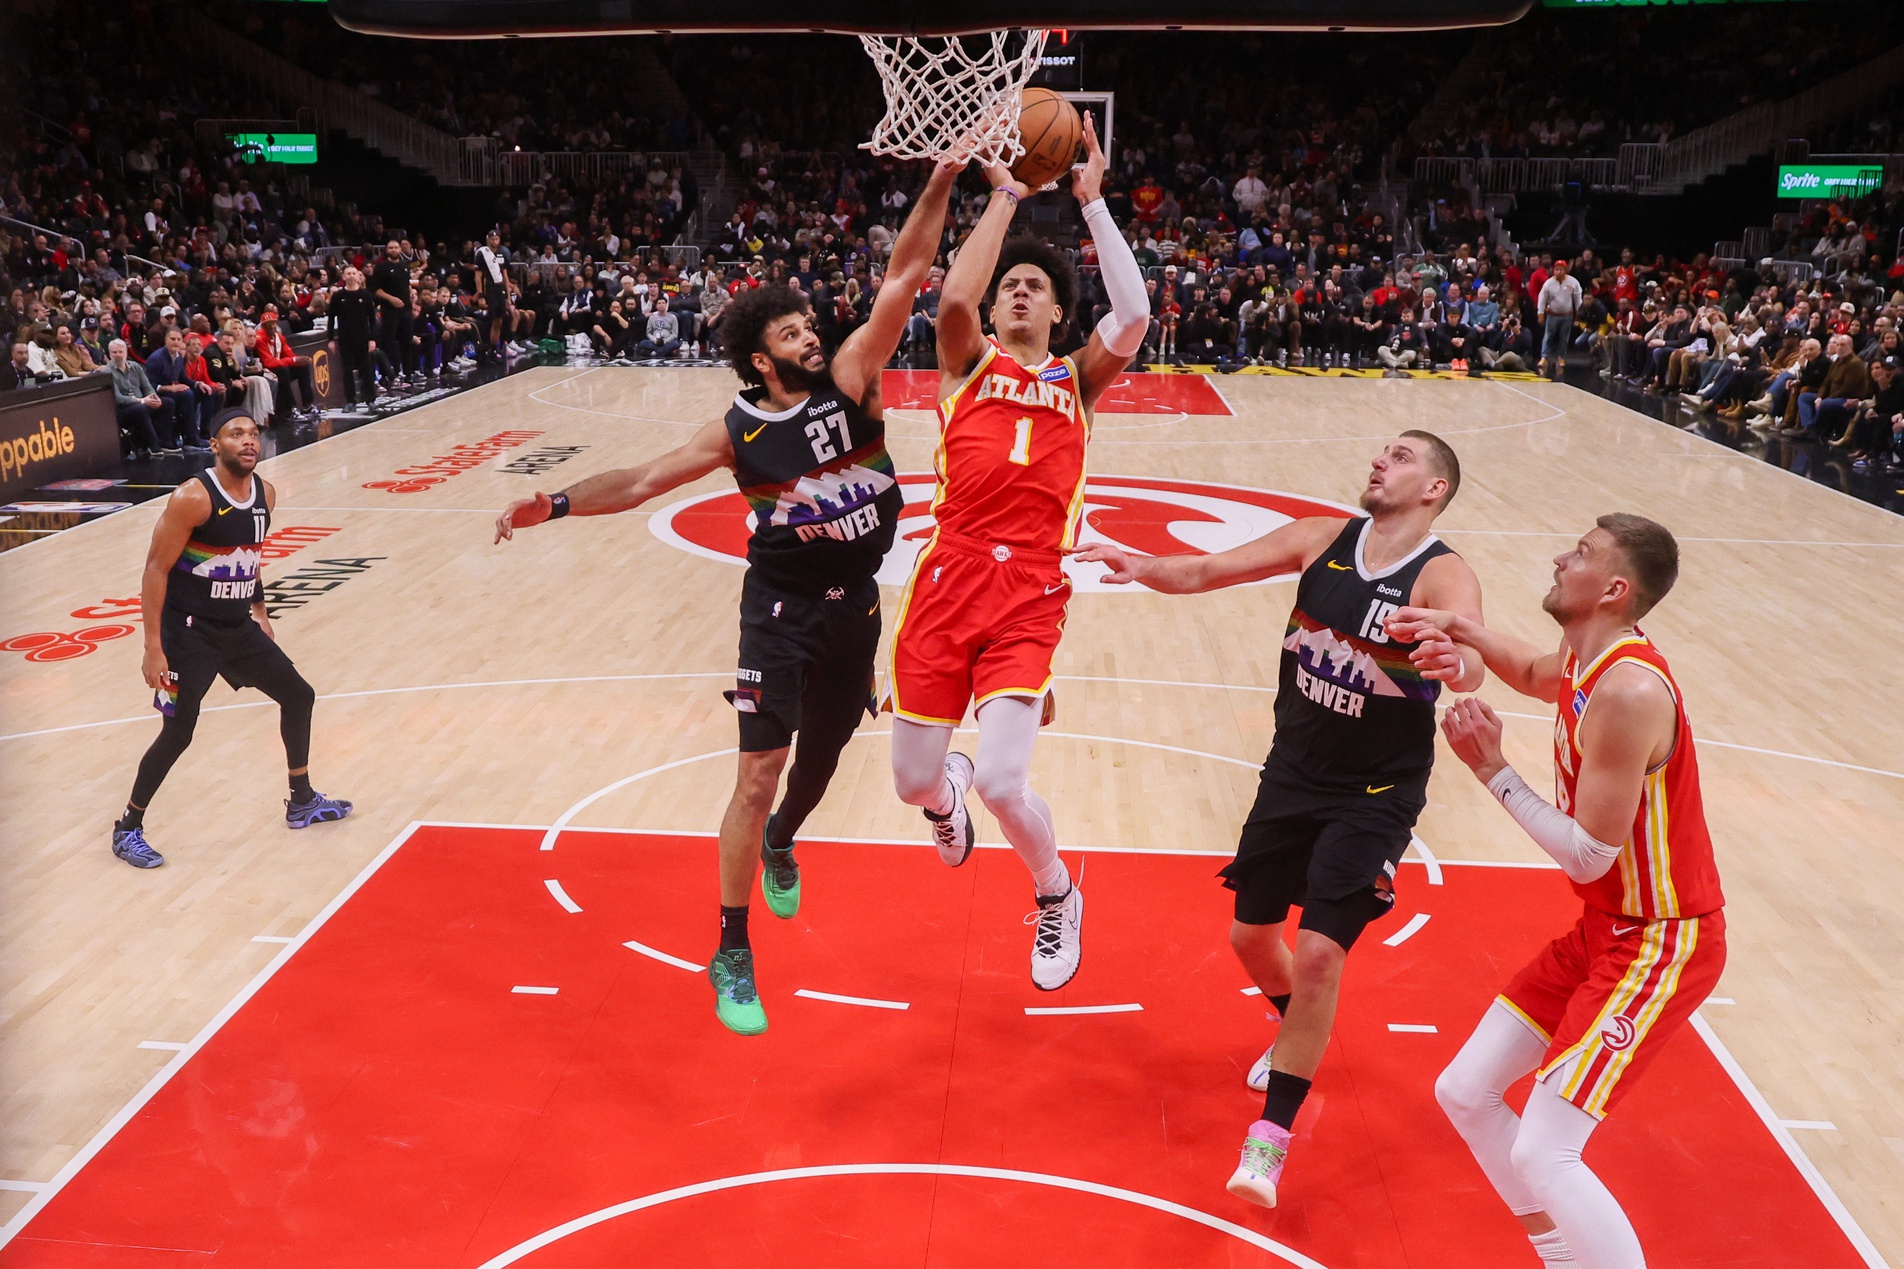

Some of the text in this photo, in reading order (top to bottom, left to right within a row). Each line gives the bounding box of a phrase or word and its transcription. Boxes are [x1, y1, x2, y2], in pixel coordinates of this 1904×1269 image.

[1781, 173, 1820, 190] Sprite
[315, 364, 330, 390] ups
[1040, 368, 1067, 380] paze
[807, 400, 838, 418] ibotta
[974, 373, 1076, 425] ATLANTA
[0, 417, 75, 482] ppable
[804, 410, 853, 464] 27
[1008, 416, 1034, 466] 1
[494, 445, 591, 475] ARENA
[253, 515, 266, 543] 11
[795, 503, 881, 543] DENVER
[1376, 583, 1403, 598] ibotta
[1358, 598, 1400, 644] 15
[1296, 662, 1365, 718] DENVER
